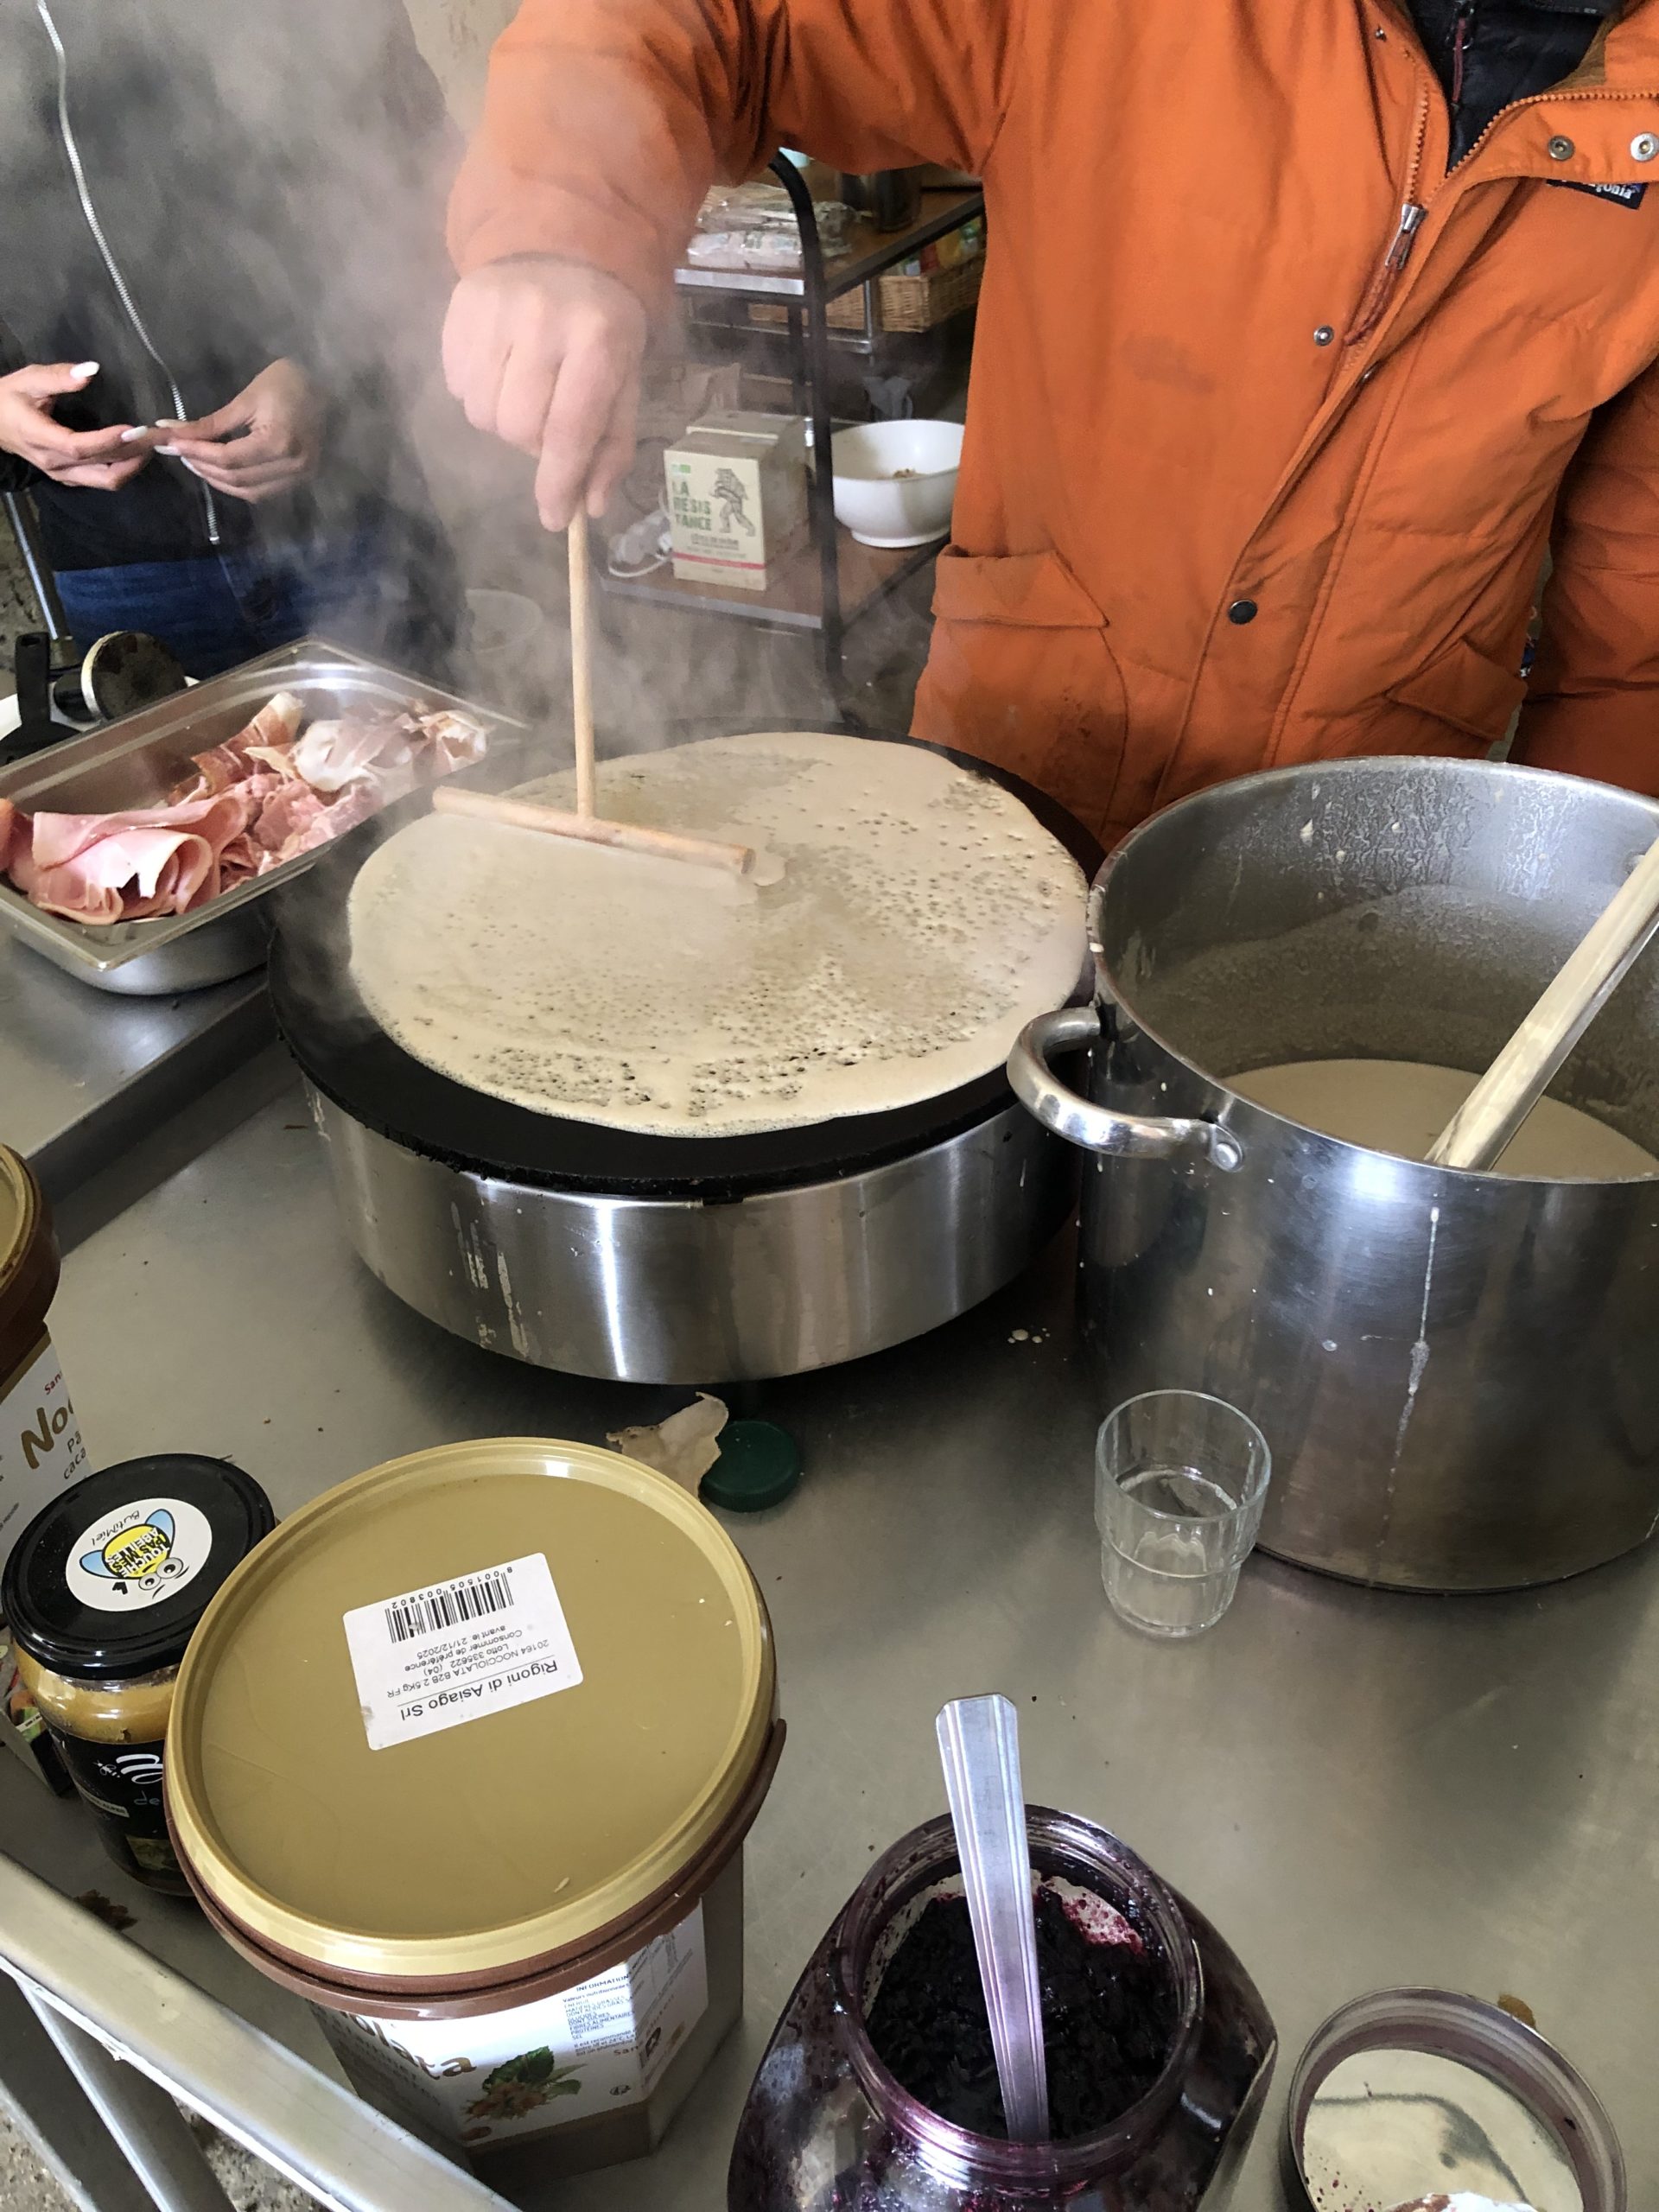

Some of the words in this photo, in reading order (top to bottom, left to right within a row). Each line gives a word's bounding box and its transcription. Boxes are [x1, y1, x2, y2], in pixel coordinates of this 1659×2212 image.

[105, 1528, 159, 1566] ABEILLES
[140, 1535, 163, 1554] PAS
[111, 1547, 142, 1572] MES
[119, 1542, 170, 1579] TOUCHE
[468, 1630, 523, 1653] Consommer
[480, 1625, 506, 1639] avant
[416, 1638, 468, 1660] 21/12/2025
[454, 1646, 467, 1657] de
[486, 1643, 509, 1656] Lotto
[520, 1638, 550, 1656] 20164
[404, 1650, 454, 1672] préférence
[423, 1662, 442, 1676] (04)
[452, 1649, 518, 1677] NOCCIOLATA
[431, 1670, 451, 1683] B2B
[506, 1659, 558, 1685] Rigoni
[386, 1687, 402, 1699] FR
[487, 1678, 503, 1694] di
[428, 1684, 484, 1711] Asiago
[400, 1702, 423, 1720] Srl
